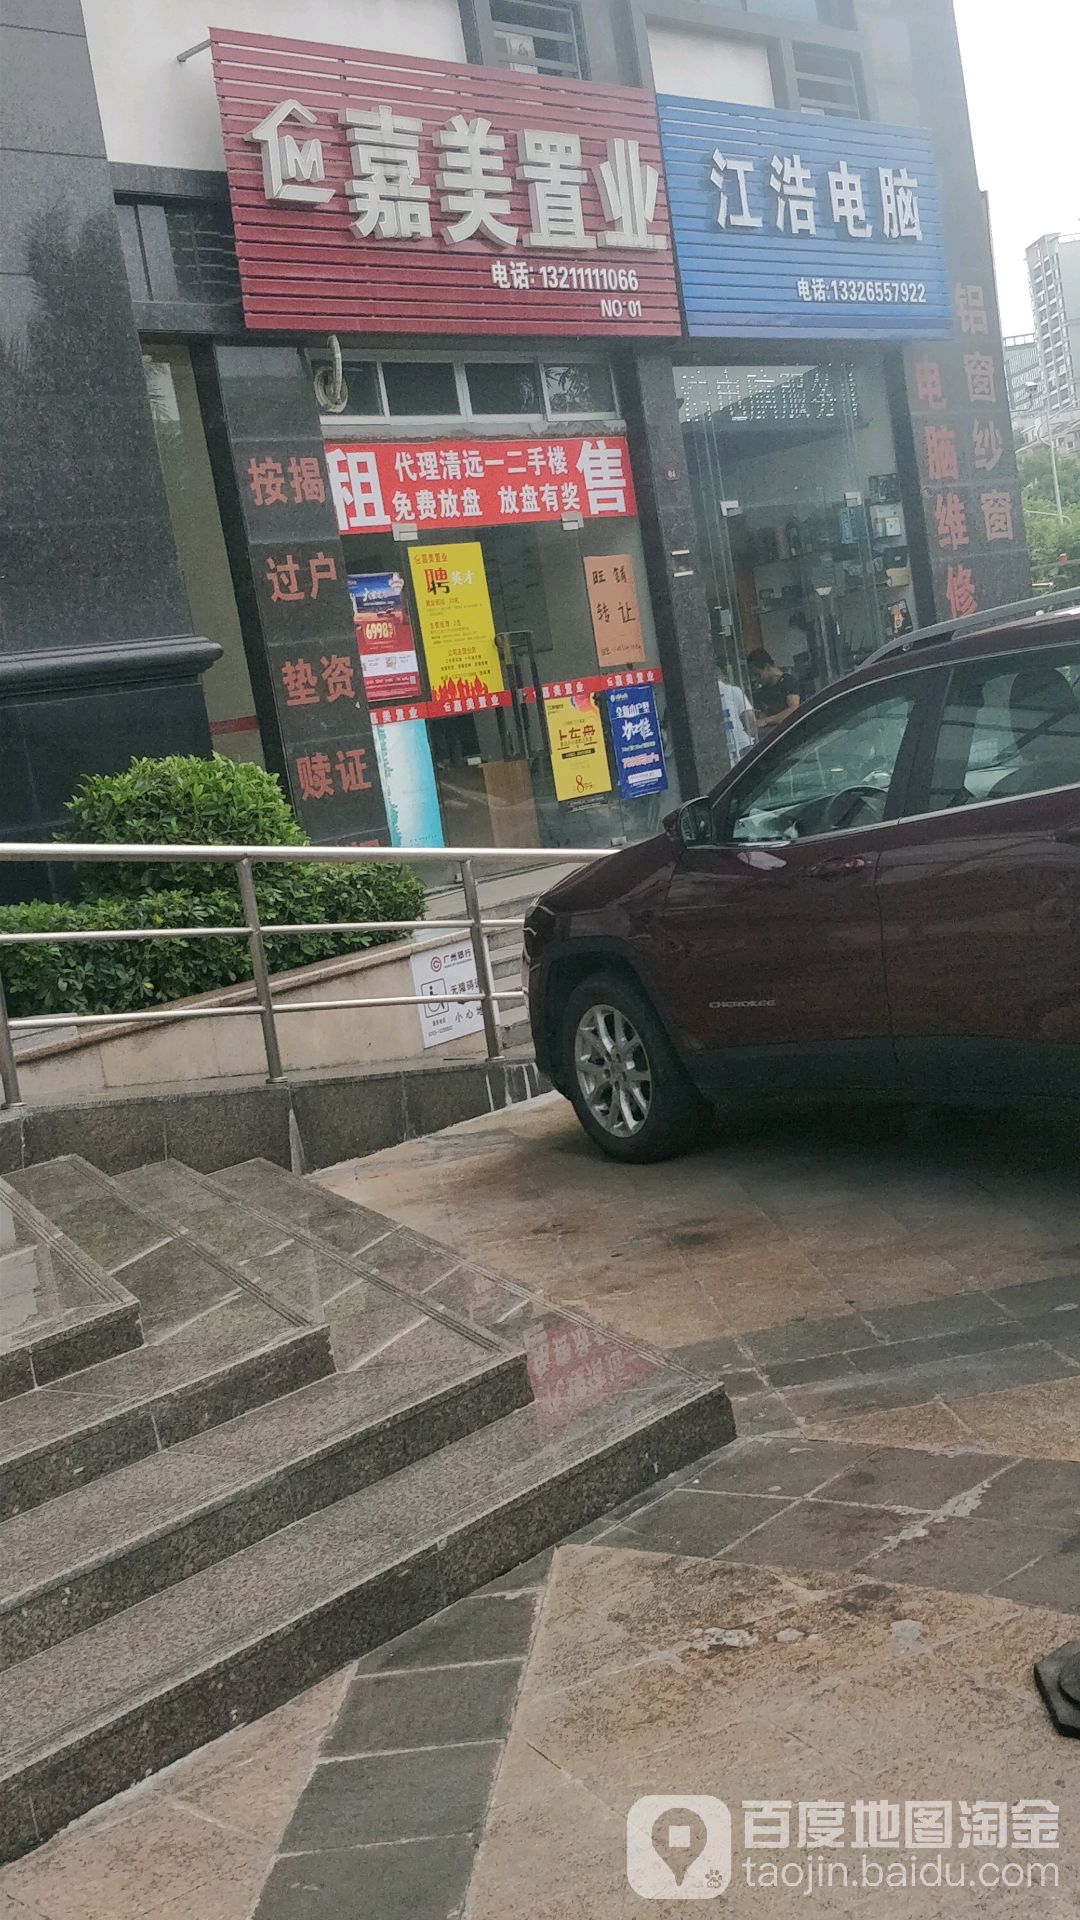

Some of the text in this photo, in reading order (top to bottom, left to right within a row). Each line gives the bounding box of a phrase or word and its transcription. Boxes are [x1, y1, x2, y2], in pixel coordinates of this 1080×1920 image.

[341, 105, 667, 250] 嘉美置业
[710, 148, 922, 241] 江浩电脑
[248, 457, 326, 506] 按揭
[328, 448, 390, 531] 租
[393, 445, 569, 483] 代理清远一二手楼
[576, 440, 627, 515] 售
[915, 354, 977, 618] 电脑维修
[391, 482, 581, 521] 免费放盘 放盘有奖
[266, 551, 337, 602] 过户
[424, 568, 450, 595] 聘
[281, 654, 356, 707] 垫资
[296, 749, 372, 800] 赎证
[443, 949, 472, 964] 广州银行
